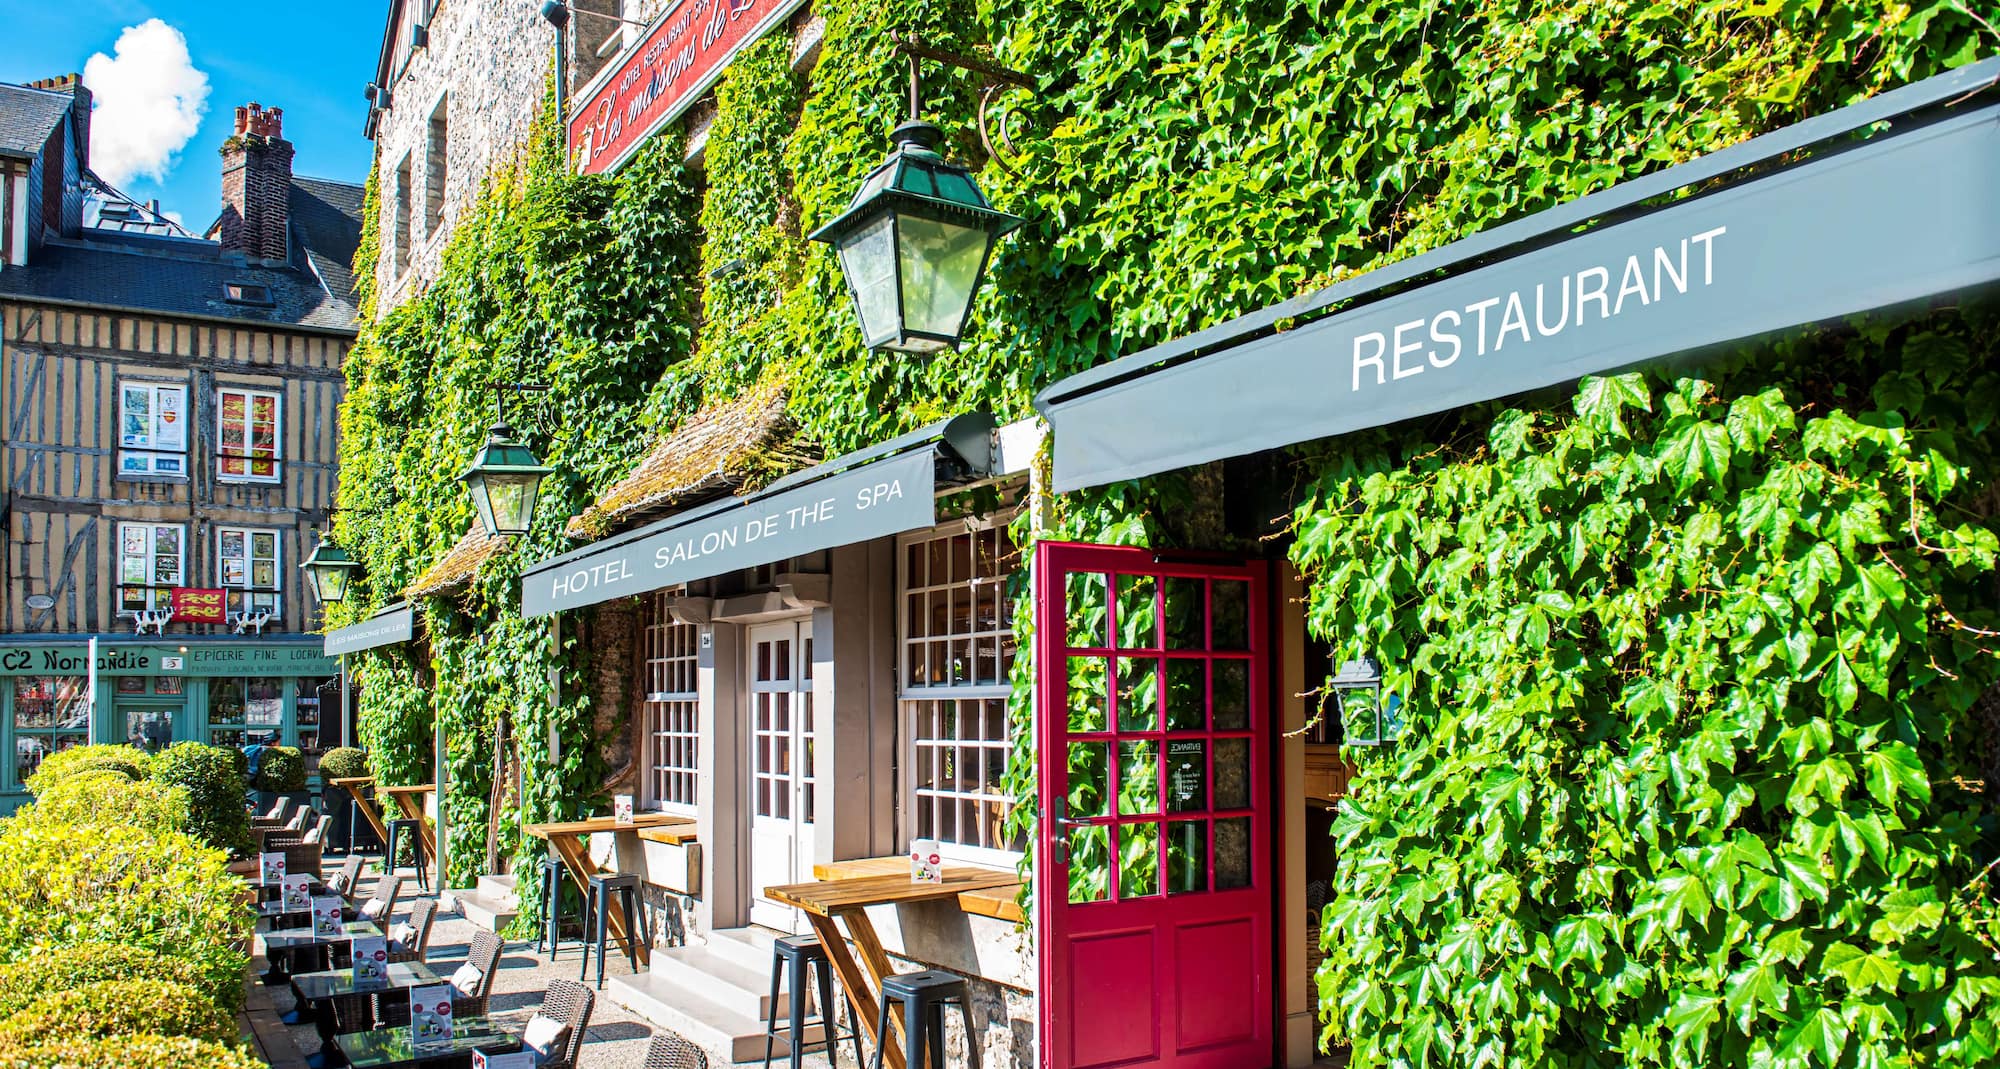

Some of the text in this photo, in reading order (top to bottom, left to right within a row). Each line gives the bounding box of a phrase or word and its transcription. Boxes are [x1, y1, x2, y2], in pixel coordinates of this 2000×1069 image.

[594, 0, 727, 158] Les maisons de
[643, 9, 692, 70] RESTAURANT
[1351, 226, 1726, 392] RESTAURANT
[552, 479, 904, 600] HOTEL SALON DE THE SPA
[254, 650, 278, 660] FINE
[290, 650, 340, 660] LOCAVO
